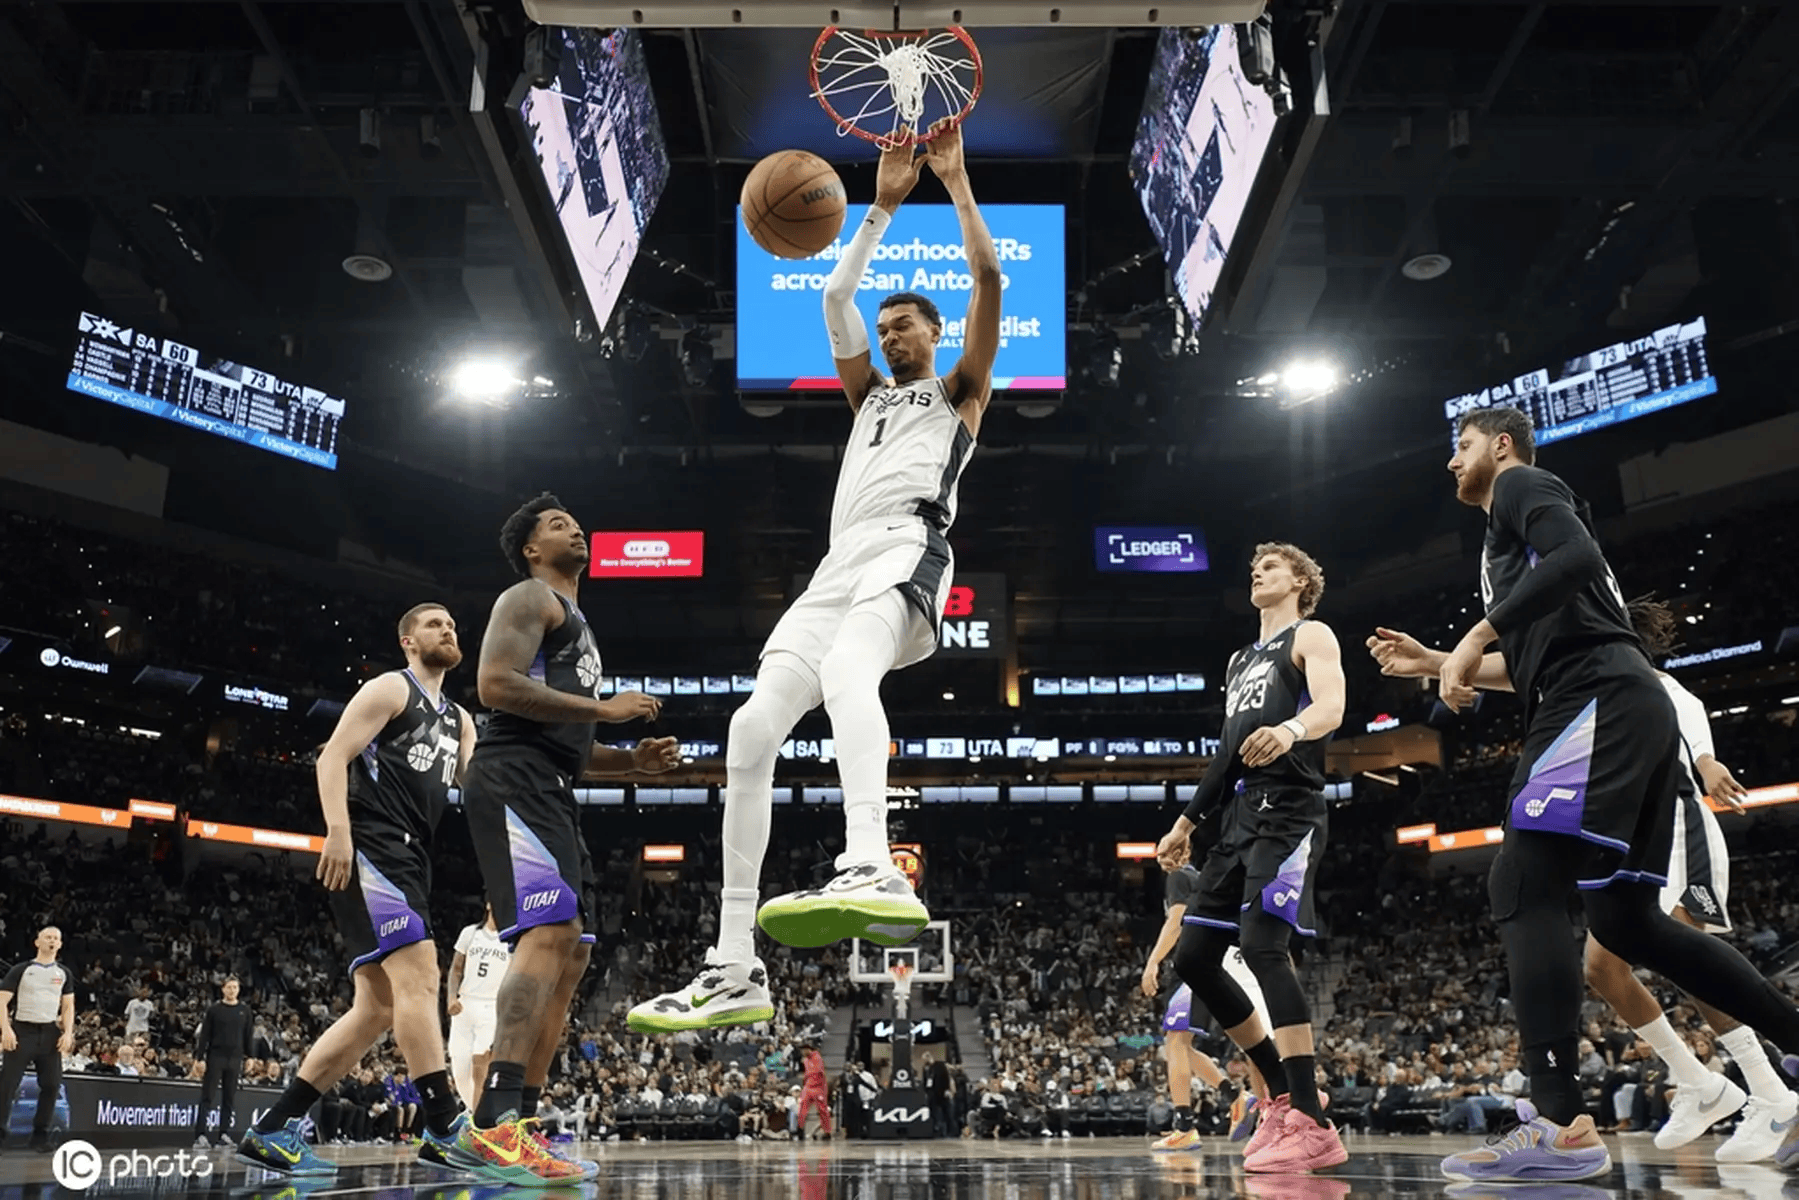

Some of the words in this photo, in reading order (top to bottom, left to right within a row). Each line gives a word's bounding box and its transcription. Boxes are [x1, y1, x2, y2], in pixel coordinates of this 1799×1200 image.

[770, 273, 832, 291] acro
[858, 267, 905, 291] San
[909, 267, 1011, 291] Antoo
[939, 315, 1041, 338] etdist
[136, 333, 157, 353] SA
[169, 344, 190, 363] 60
[1600, 348, 1618, 366] 73
[1626, 335, 1656, 356] UTA
[250, 370, 268, 390] 73
[275, 379, 302, 400] UTA
[1491, 383, 1513, 401] SA
[1522, 373, 1541, 392] 60
[868, 417, 888, 449] 1
[1120, 541, 1182, 556] LEDGER
[1238, 679, 1268, 712] 23
[795, 740, 820, 758] SA
[939, 741, 953, 757] 73
[967, 739, 1004, 756] UTA
[523, 888, 561, 912] UTAH
[379, 915, 410, 938] UTAH
[477, 962, 489, 978] 5
[97, 1099, 165, 1126] Movement
[169, 1103, 192, 1126] that
